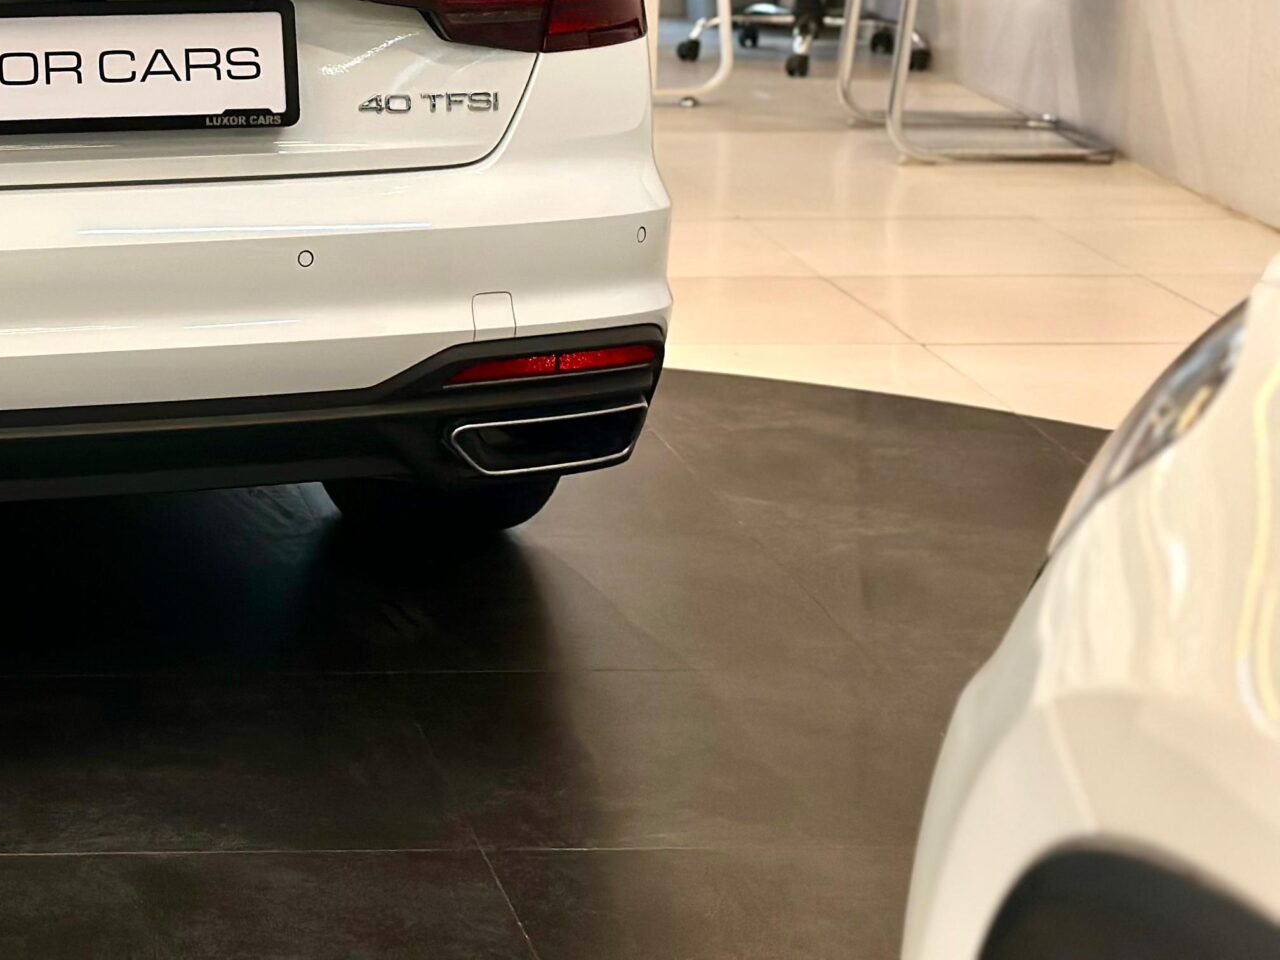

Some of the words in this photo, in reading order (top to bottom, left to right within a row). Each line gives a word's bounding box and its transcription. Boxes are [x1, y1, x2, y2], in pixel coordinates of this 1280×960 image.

[98, 46, 262, 83] CARS
[358, 94, 412, 115] 40
[420, 91, 500, 114] TFSI
[205, 115, 247, 127] LUXOR
[249, 114, 282, 126] CARS
